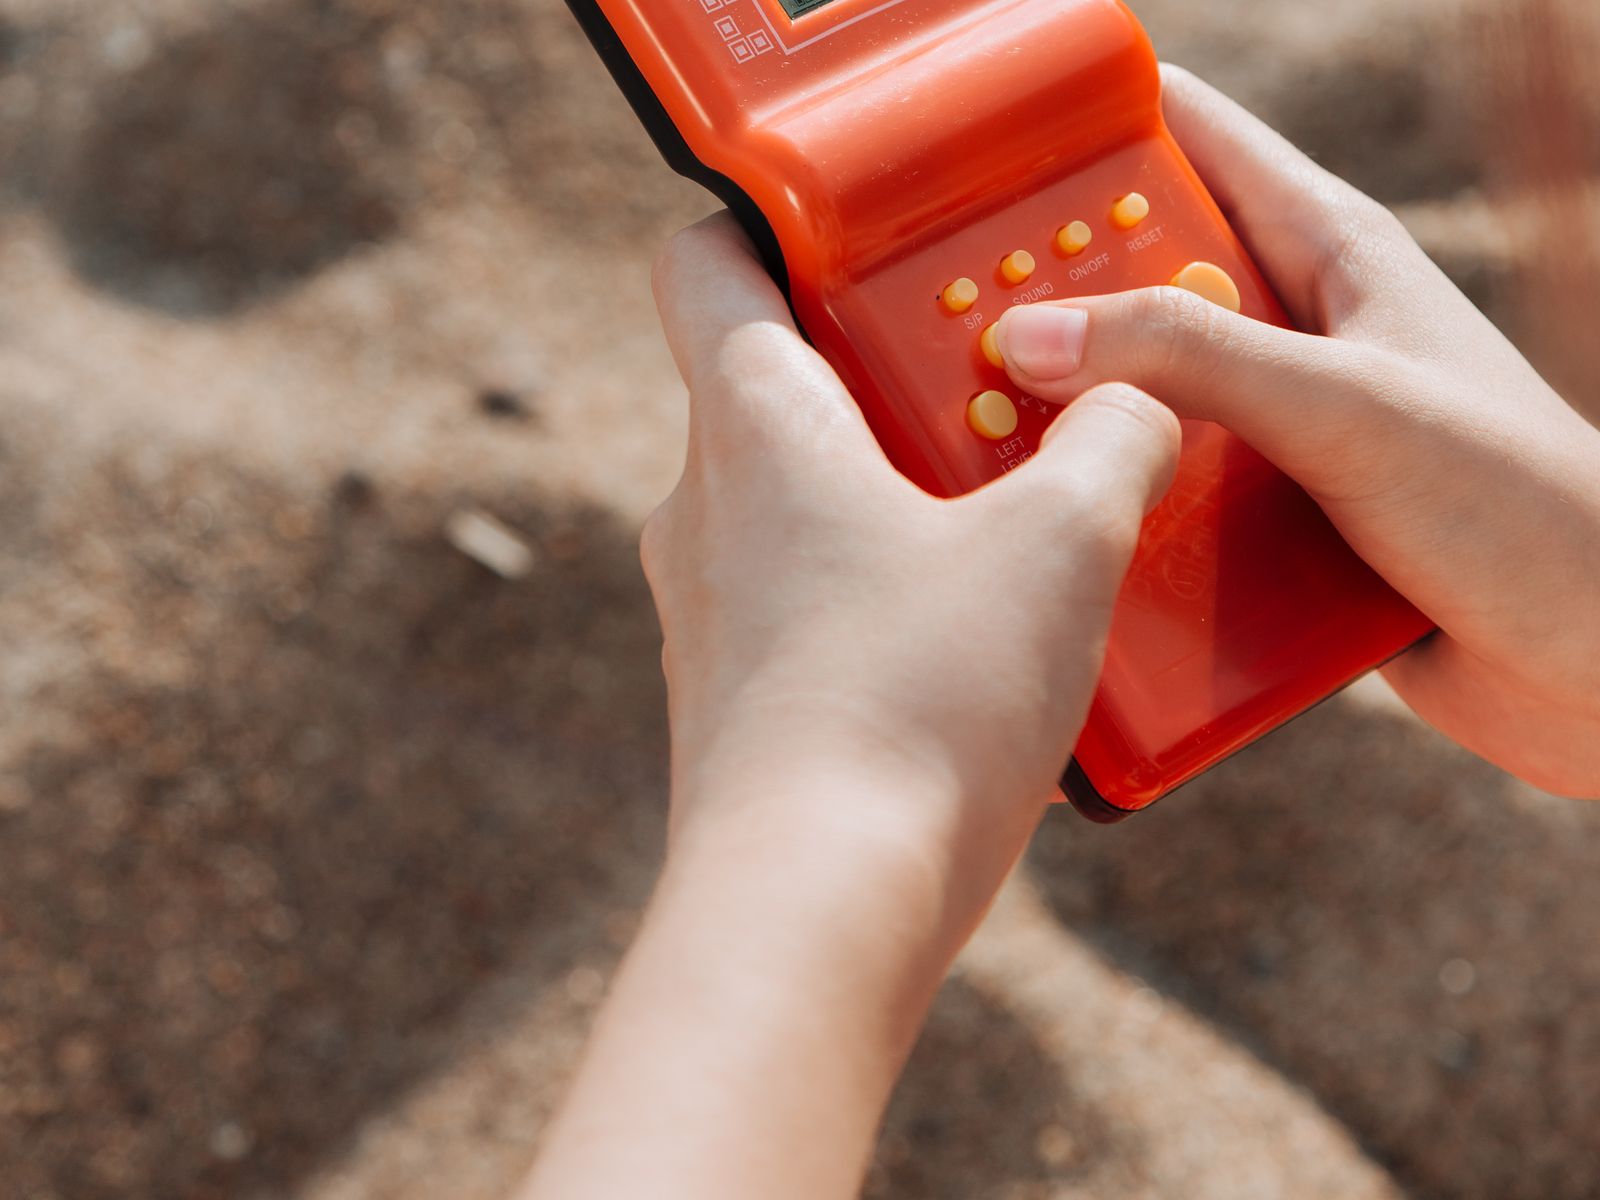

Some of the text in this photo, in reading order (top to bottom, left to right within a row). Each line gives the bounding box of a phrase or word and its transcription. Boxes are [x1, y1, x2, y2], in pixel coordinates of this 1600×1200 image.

[1126, 226, 1164, 253] RESET
[1068, 252, 1111, 282] ON/OFF
[1012, 282, 1054, 306] SOUND
[964, 312, 984, 330] S/P
[995, 435, 1025, 459] LEFT
